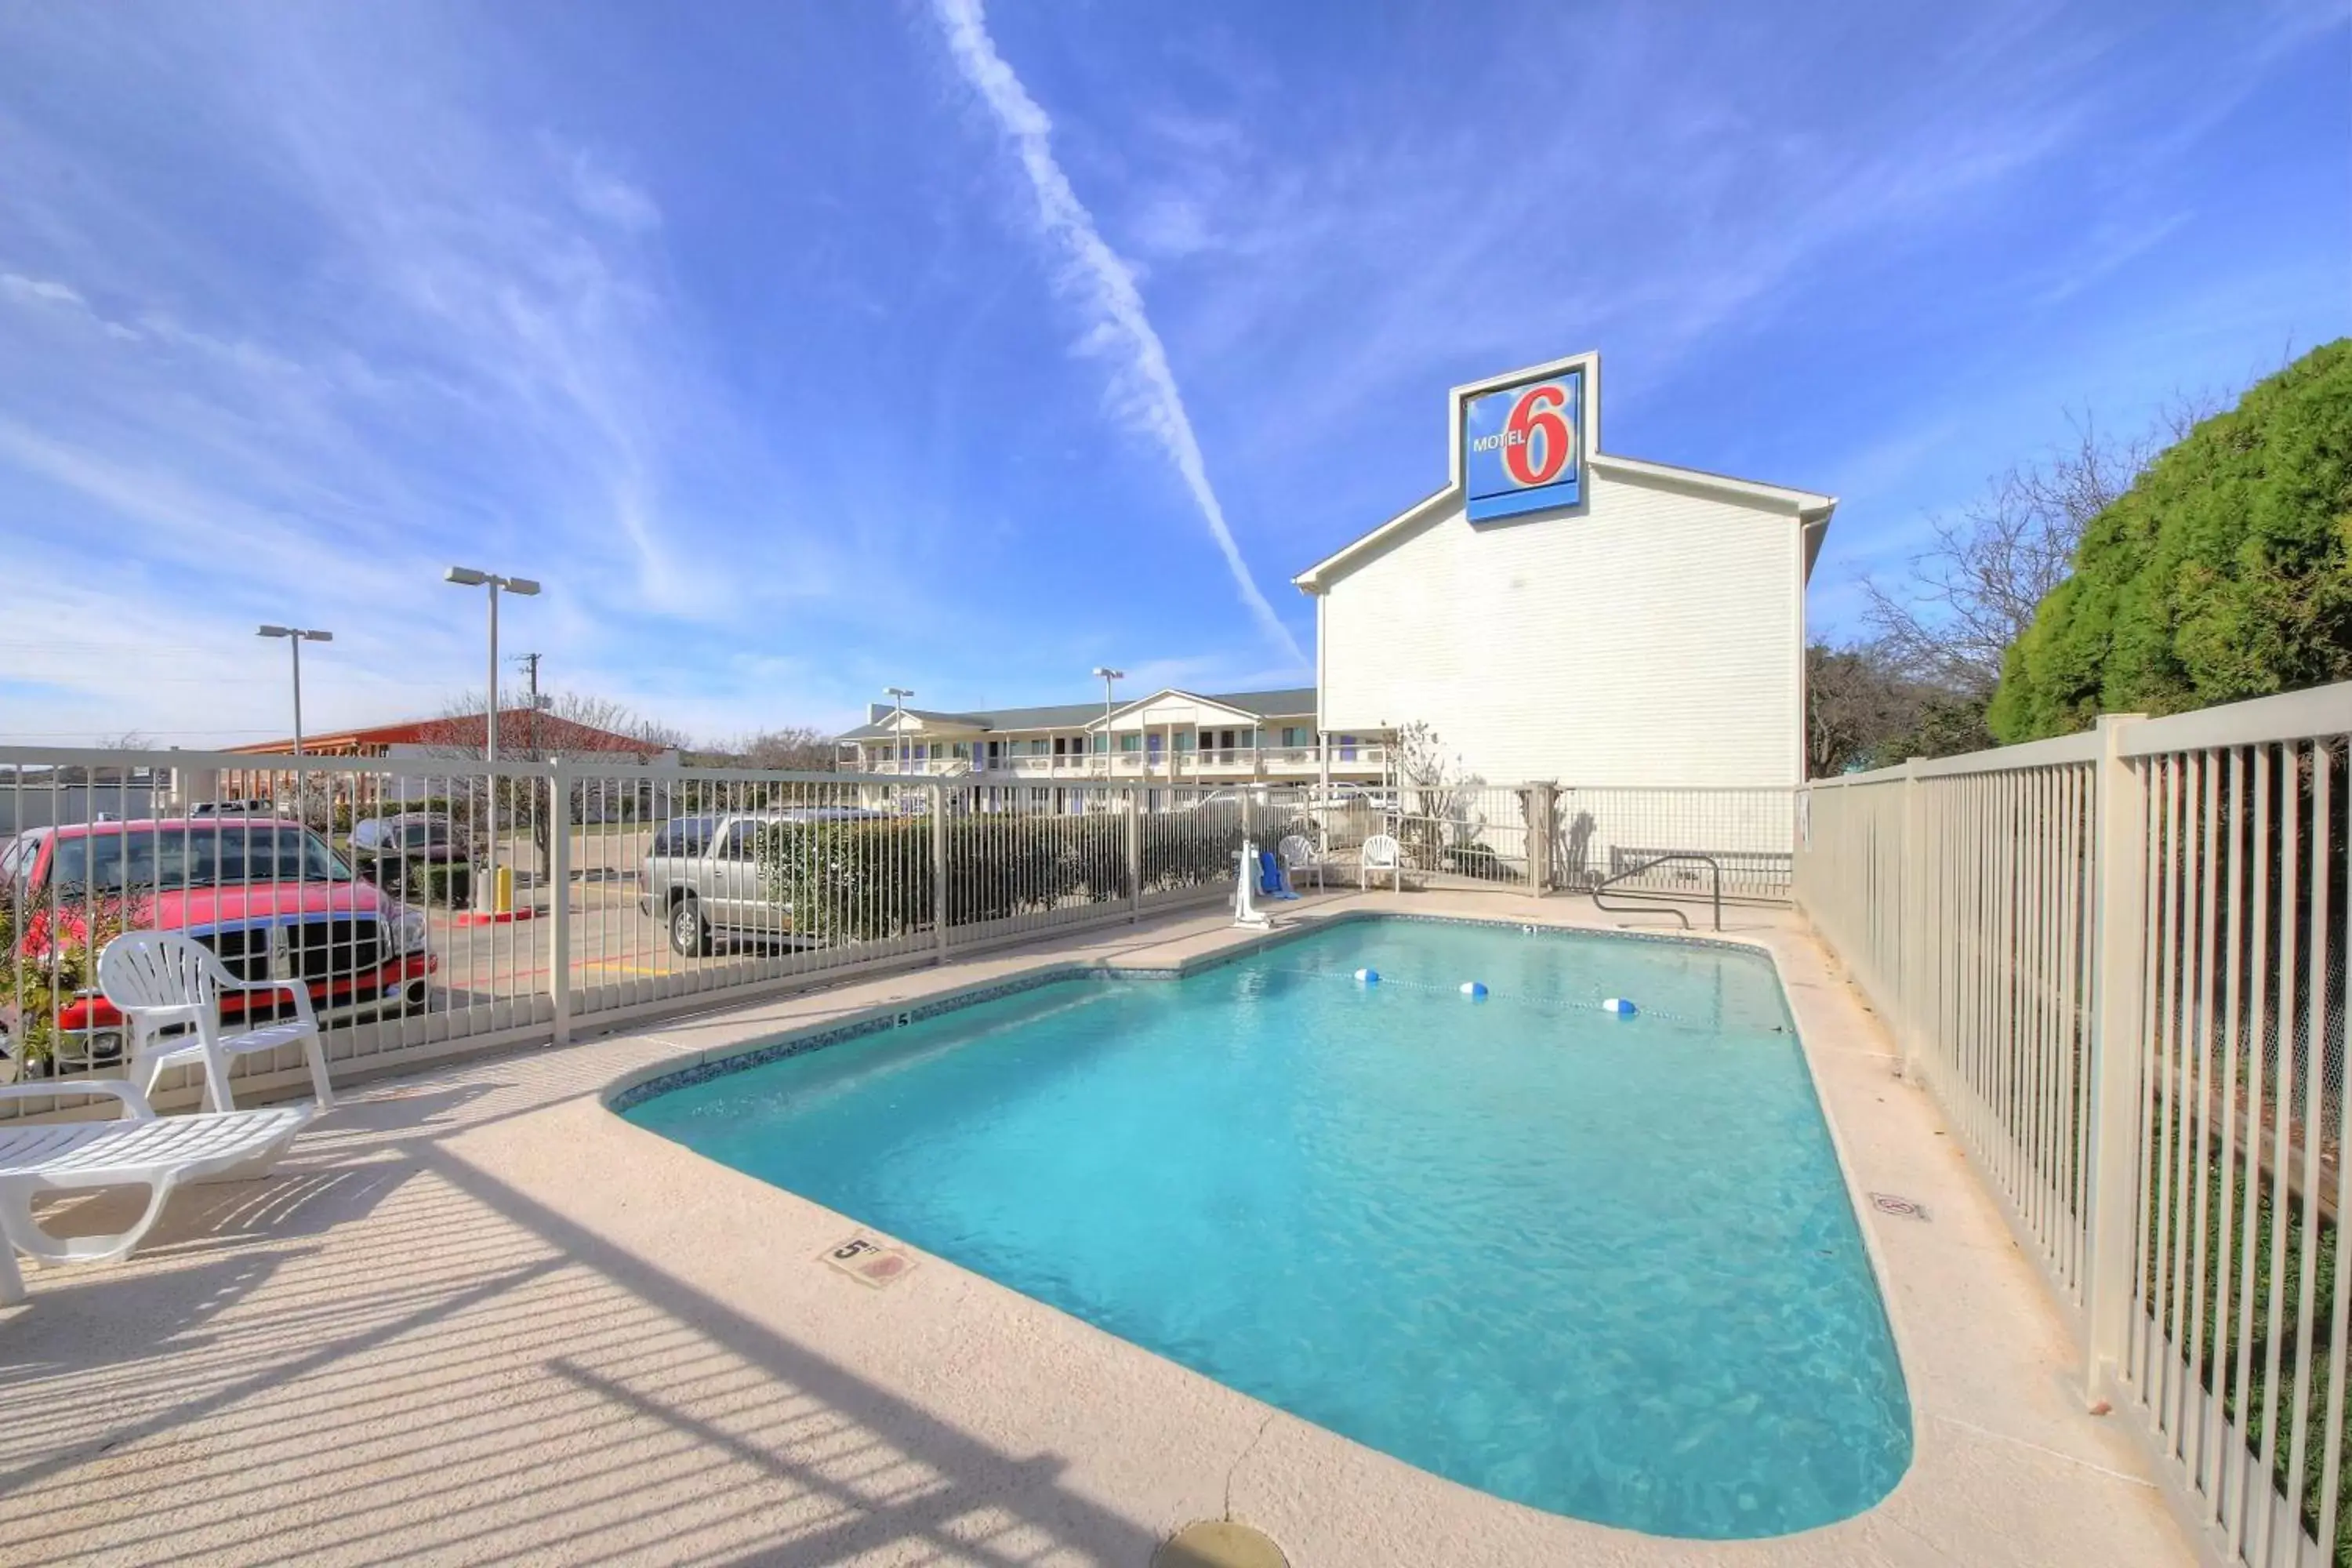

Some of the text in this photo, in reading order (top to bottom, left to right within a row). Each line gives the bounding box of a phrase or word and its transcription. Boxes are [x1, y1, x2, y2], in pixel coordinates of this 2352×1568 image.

[1473, 385, 1569, 485] MOTEL 6
[898, 1012, 908, 1027] 5
[833, 1240, 869, 1259] 5
